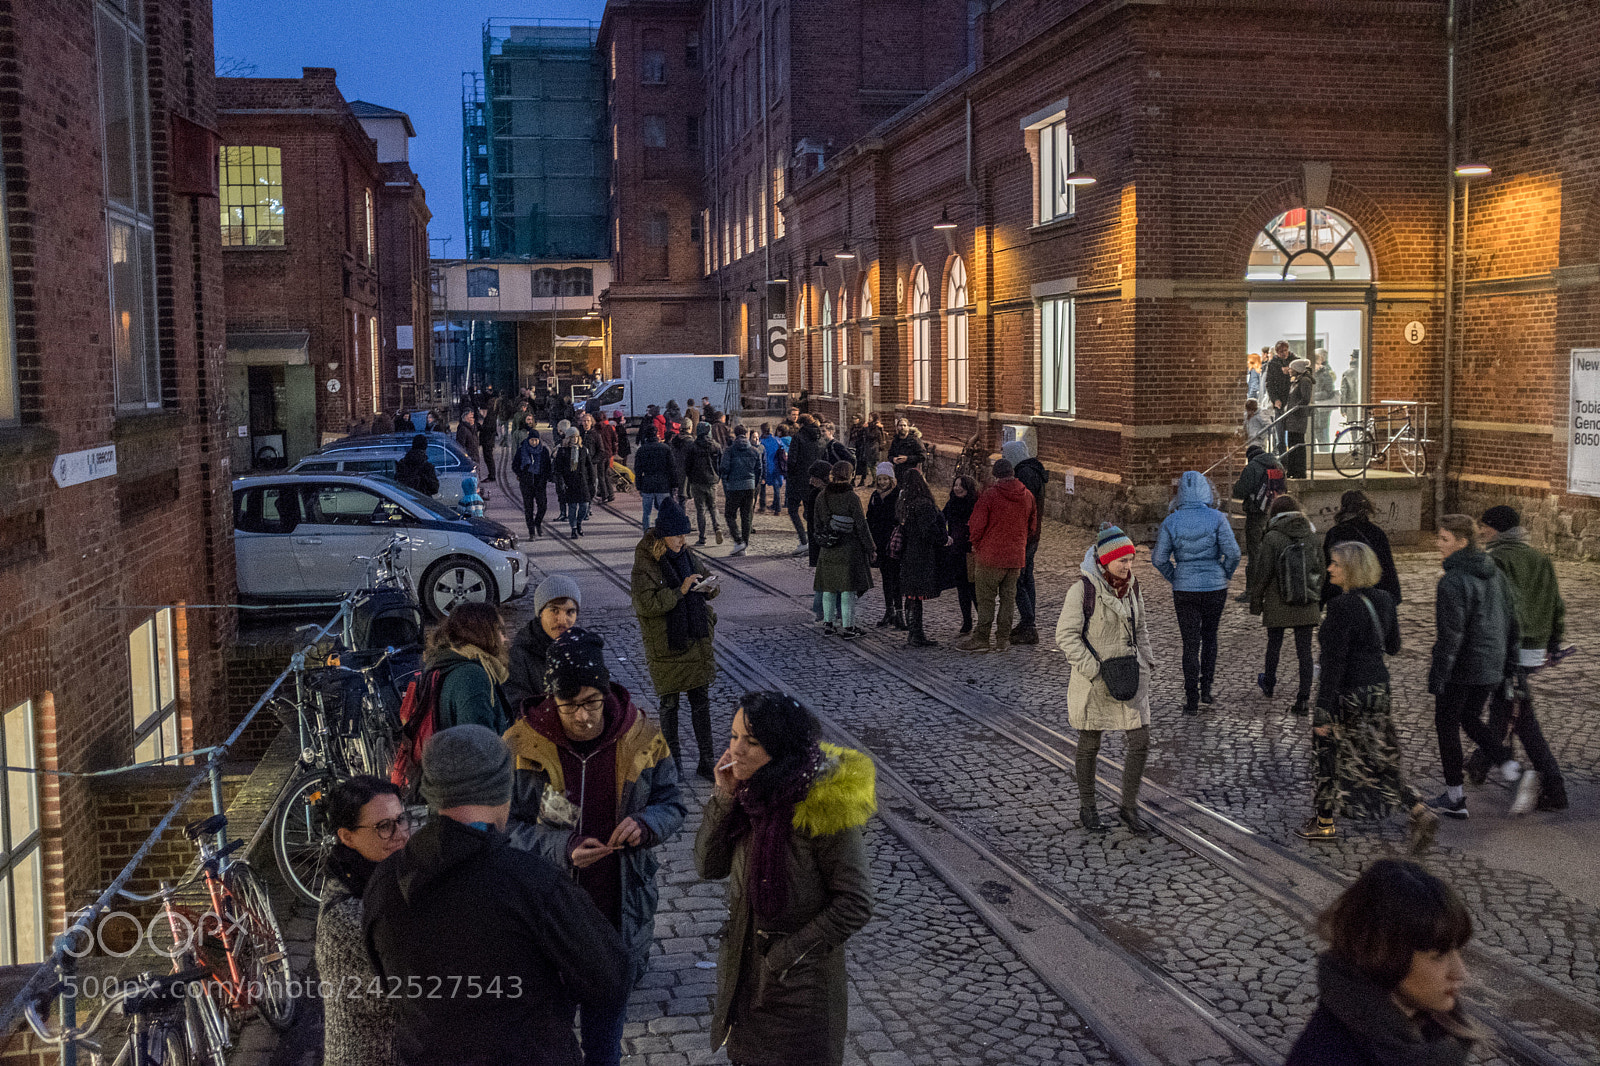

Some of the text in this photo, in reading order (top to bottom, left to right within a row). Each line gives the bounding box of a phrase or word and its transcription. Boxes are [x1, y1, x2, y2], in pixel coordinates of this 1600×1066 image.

[1411, 329, 1419, 341] B
[768, 326, 788, 362] 6
[1577, 358, 1599, 371] New
[1575, 432, 1600, 446] 8050
